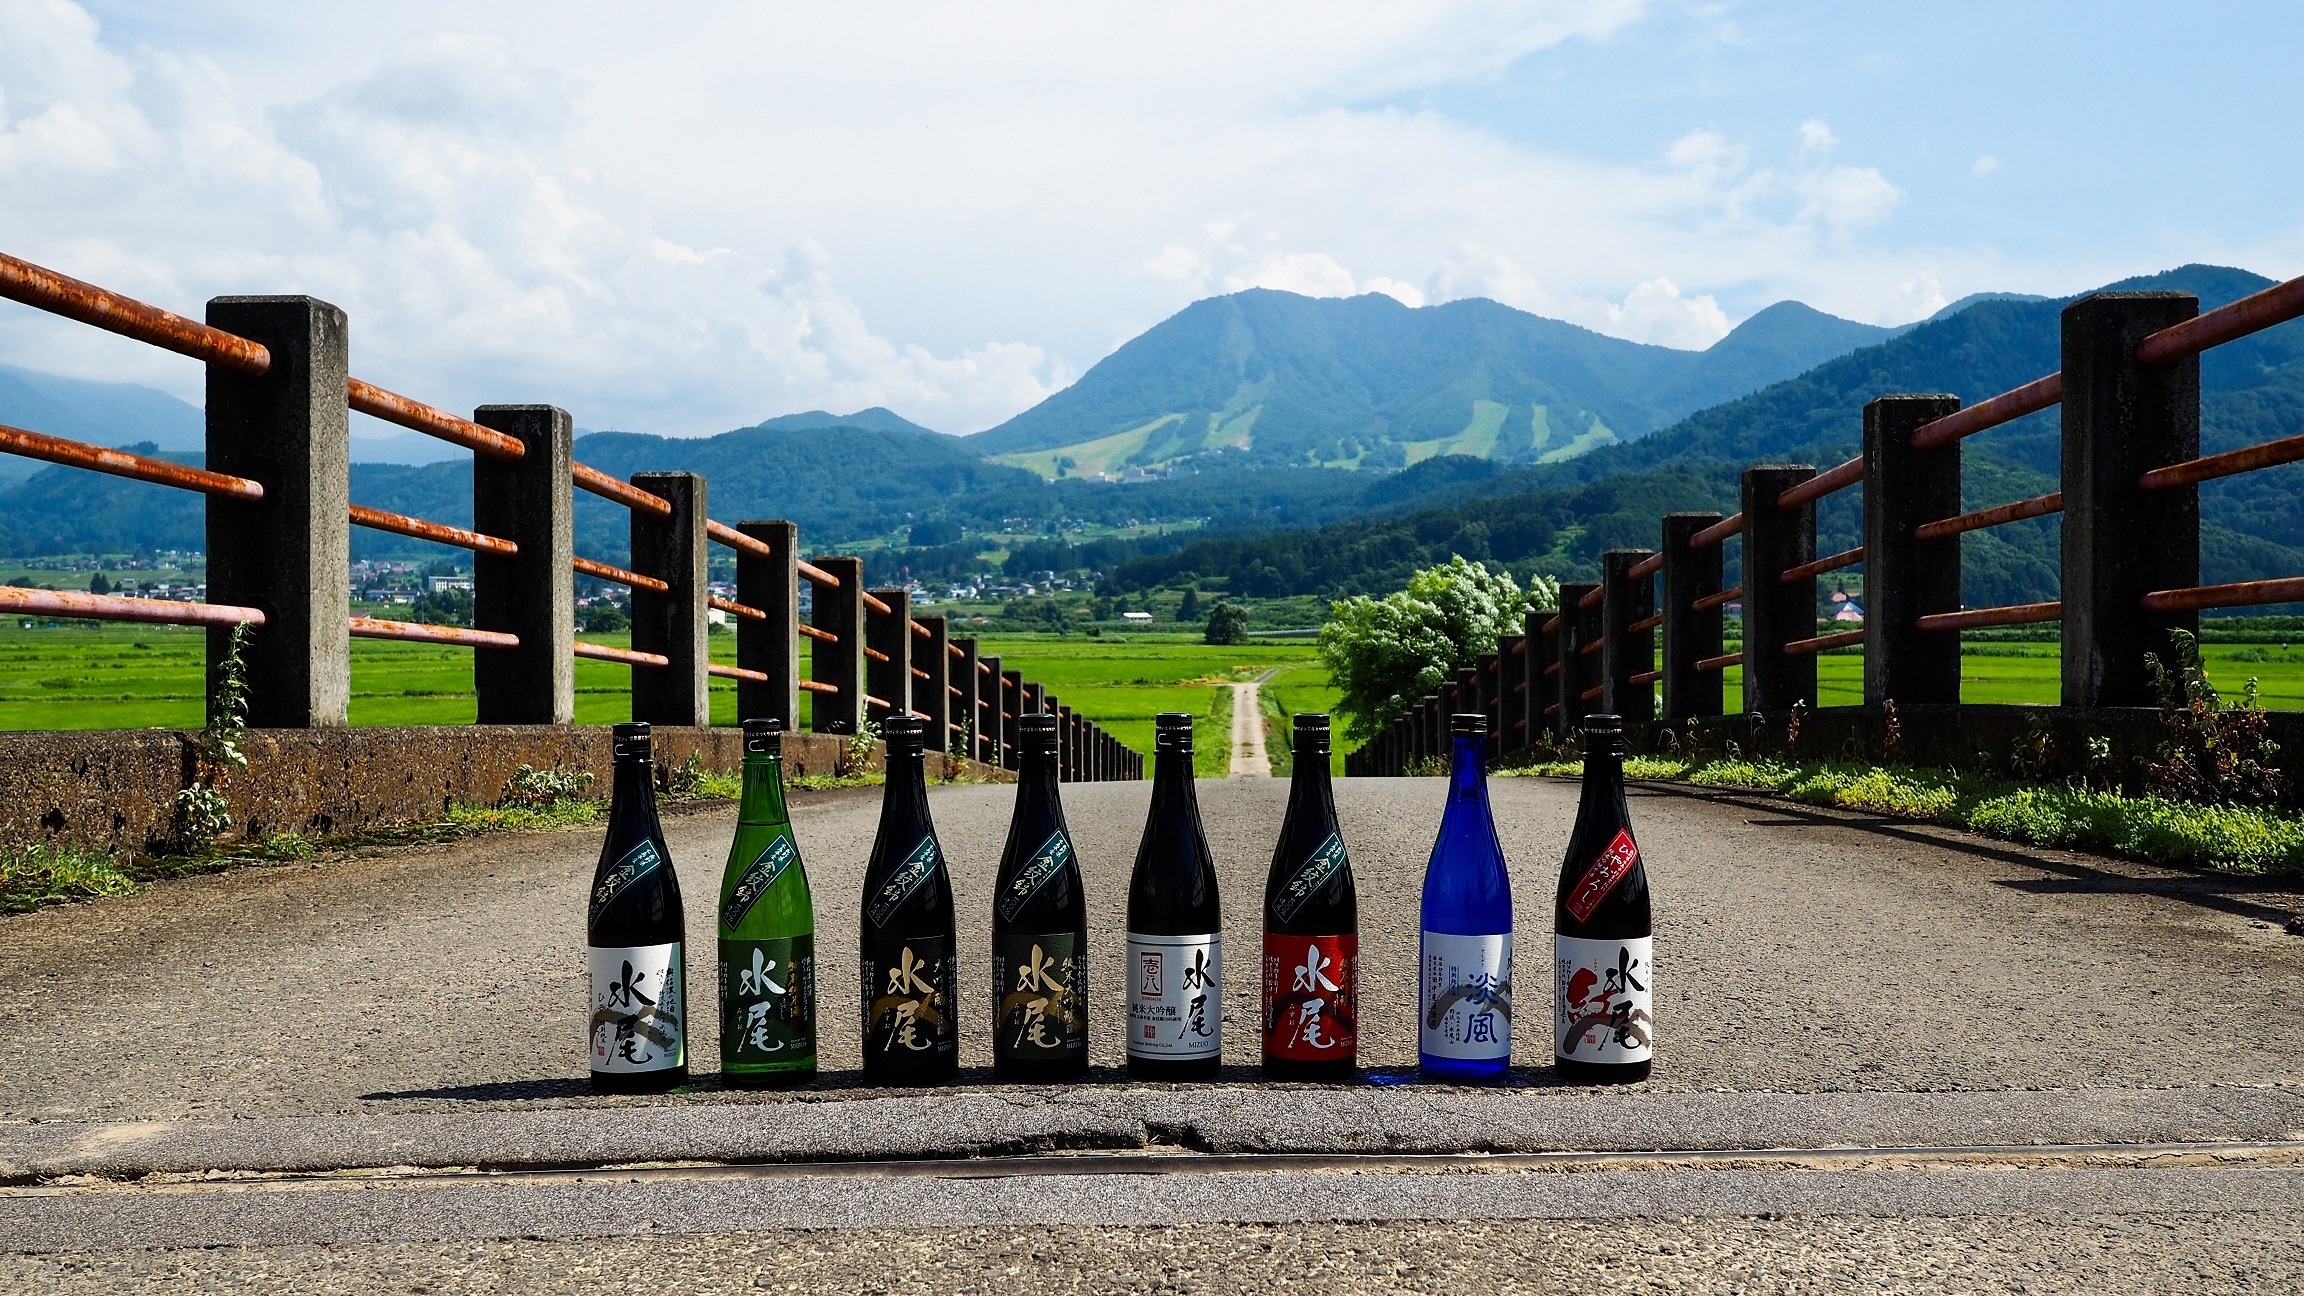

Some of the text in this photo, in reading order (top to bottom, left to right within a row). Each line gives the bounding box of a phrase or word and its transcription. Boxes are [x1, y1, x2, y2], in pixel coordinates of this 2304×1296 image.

[596, 865, 635, 903] 金紋錦
[735, 861, 776, 903] 金紋錦
[883, 861, 925, 901] 金紋錦
[1013, 856, 1054, 896] 金紋錦
[1289, 858, 1331, 897] 金紋錦
[1581, 843, 1630, 903] ひやおろし
[737, 947, 787, 1053] 水尾
[884, 946, 935, 1052] 水尾
[1013, 943, 1061, 1049] 水尾
[1143, 957, 1160, 992] 壱八
[1178, 948, 1216, 1040] 水尾
[1287, 943, 1340, 1049] 水尾
[1597, 946, 1645, 1052] 水尾
[608, 960, 653, 1066] 水尾
[1132, 1002, 1177, 1016] 純米大吟醸
[1463, 971, 1499, 1044] 淡風
[1188, 1041, 1209, 1049] MIZUO
